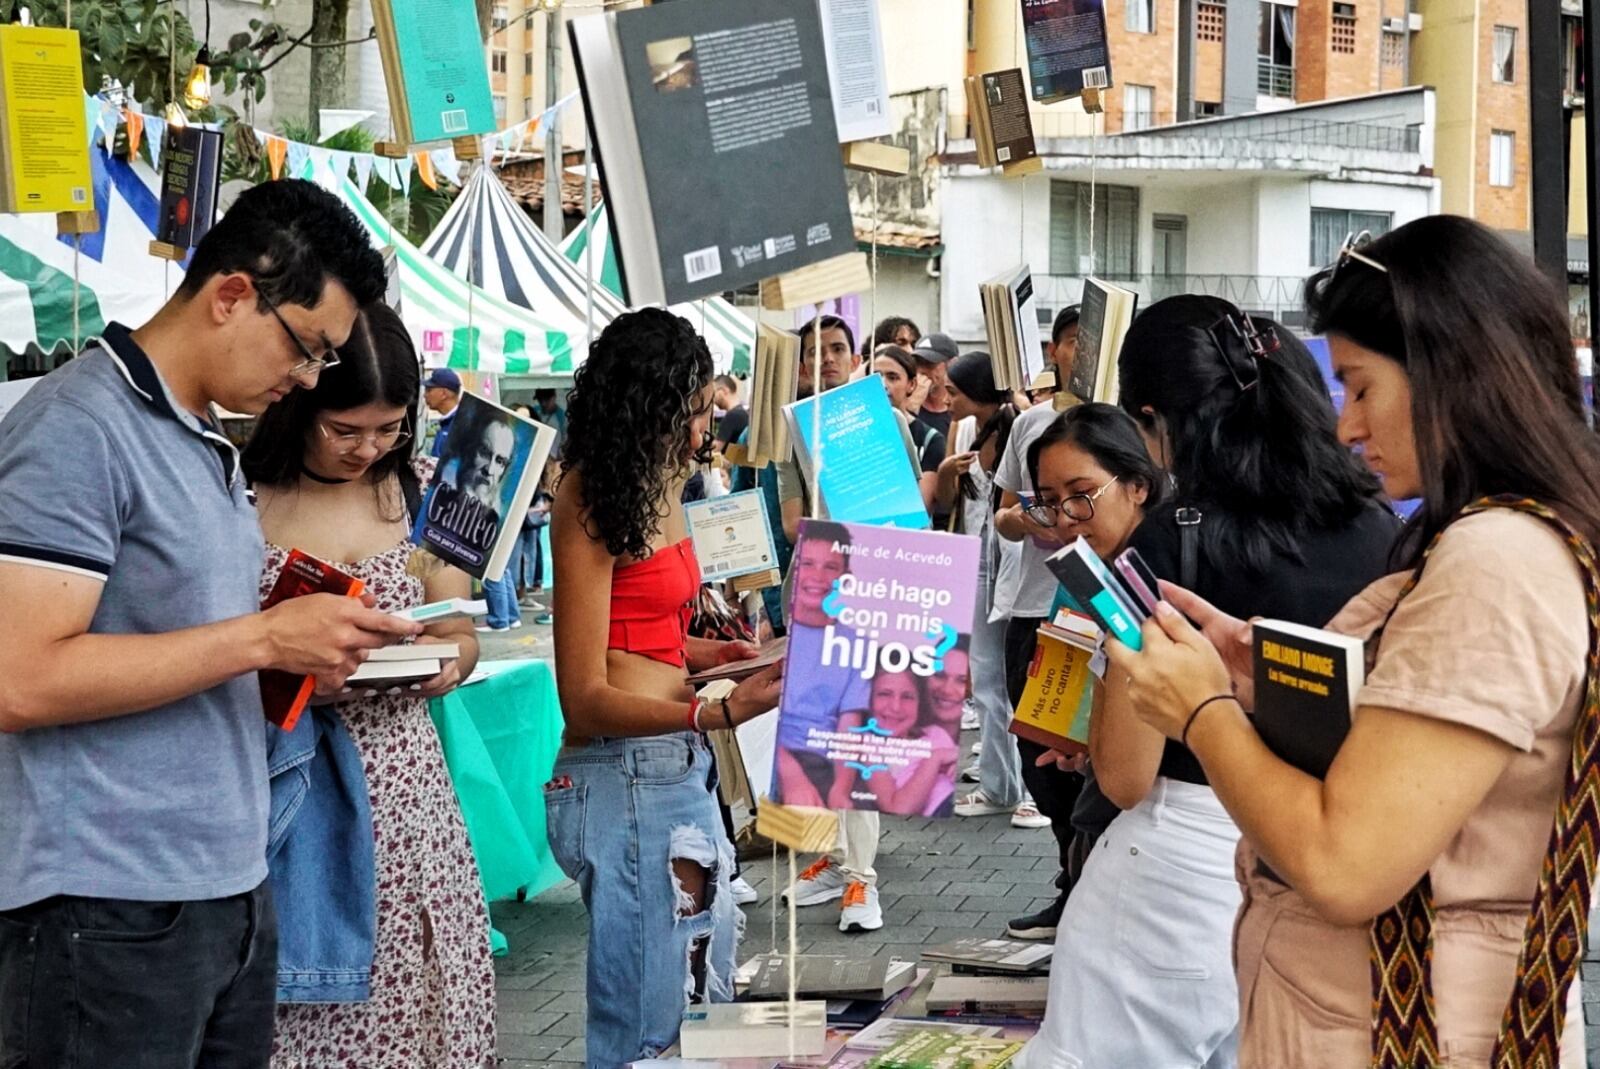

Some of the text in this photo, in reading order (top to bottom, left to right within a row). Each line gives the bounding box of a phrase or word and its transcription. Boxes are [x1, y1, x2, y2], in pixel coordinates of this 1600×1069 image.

[428, 481, 498, 550] Galileo
[831, 540, 953, 566] Annie de Acevedo
[890, 579, 952, 609] hago
[838, 607, 943, 634] con mis
[1031, 667, 1056, 720] Más claro
[1049, 697, 1061, 715] no
[1056, 662, 1073, 696] canta
[808, 728, 862, 744] Respuestas
[886, 736, 932, 750] preguntas
[828, 739, 876, 753] frecuentes
[827, 750, 859, 761] educar
